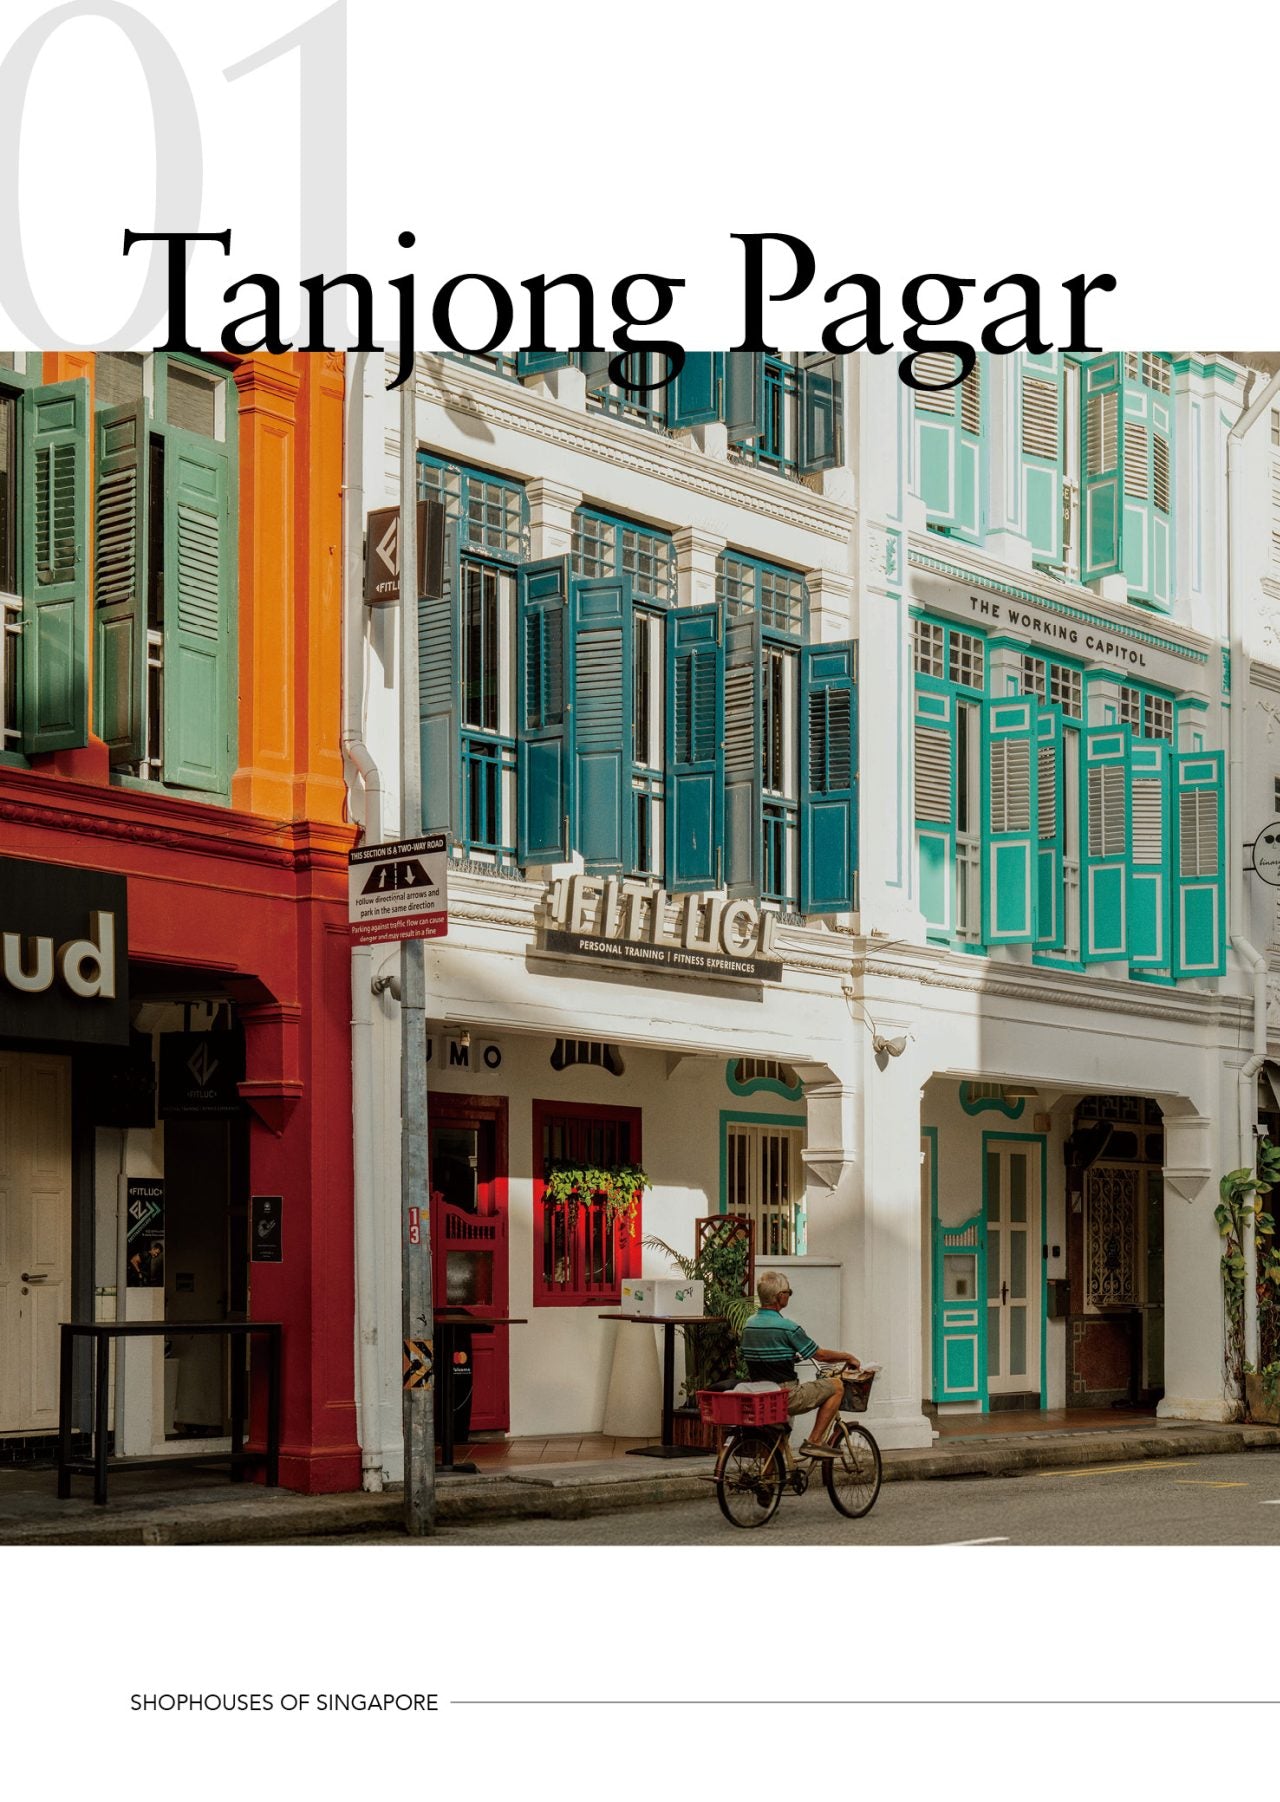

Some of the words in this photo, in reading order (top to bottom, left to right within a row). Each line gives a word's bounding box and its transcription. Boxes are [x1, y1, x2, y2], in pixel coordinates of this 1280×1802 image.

[379, 581, 400, 593] FITL
[970, 596, 1000, 619] THE
[1008, 609, 1078, 643] WORKING
[1086, 636, 1146, 667] CAPITOL
[351, 852, 363, 861] THIS
[363, 847, 386, 859] SECTION
[387, 847, 391, 855] IS
[392, 846, 398, 854] A
[398, 841, 426, 853] TWO-WAY
[426, 839, 444, 849] ROAD
[375, 892, 406, 904] directional
[406, 889, 427, 900] arrows
[428, 888, 440, 897] and
[360, 908, 373, 919] park
[374, 908, 380, 916] in
[381, 905, 390, 915] the
[391, 903, 407, 913] same
[408, 901, 435, 911] direction
[351, 925, 371, 935] Parking
[371, 923, 390, 932] against
[406, 918, 419, 927] flow
[579, 939, 623, 955] PERSONAL
[624, 946, 665, 961] TRAINING
[673, 953, 705, 967] FITNESS
[706, 958, 755, 974] EXPERIENCES
